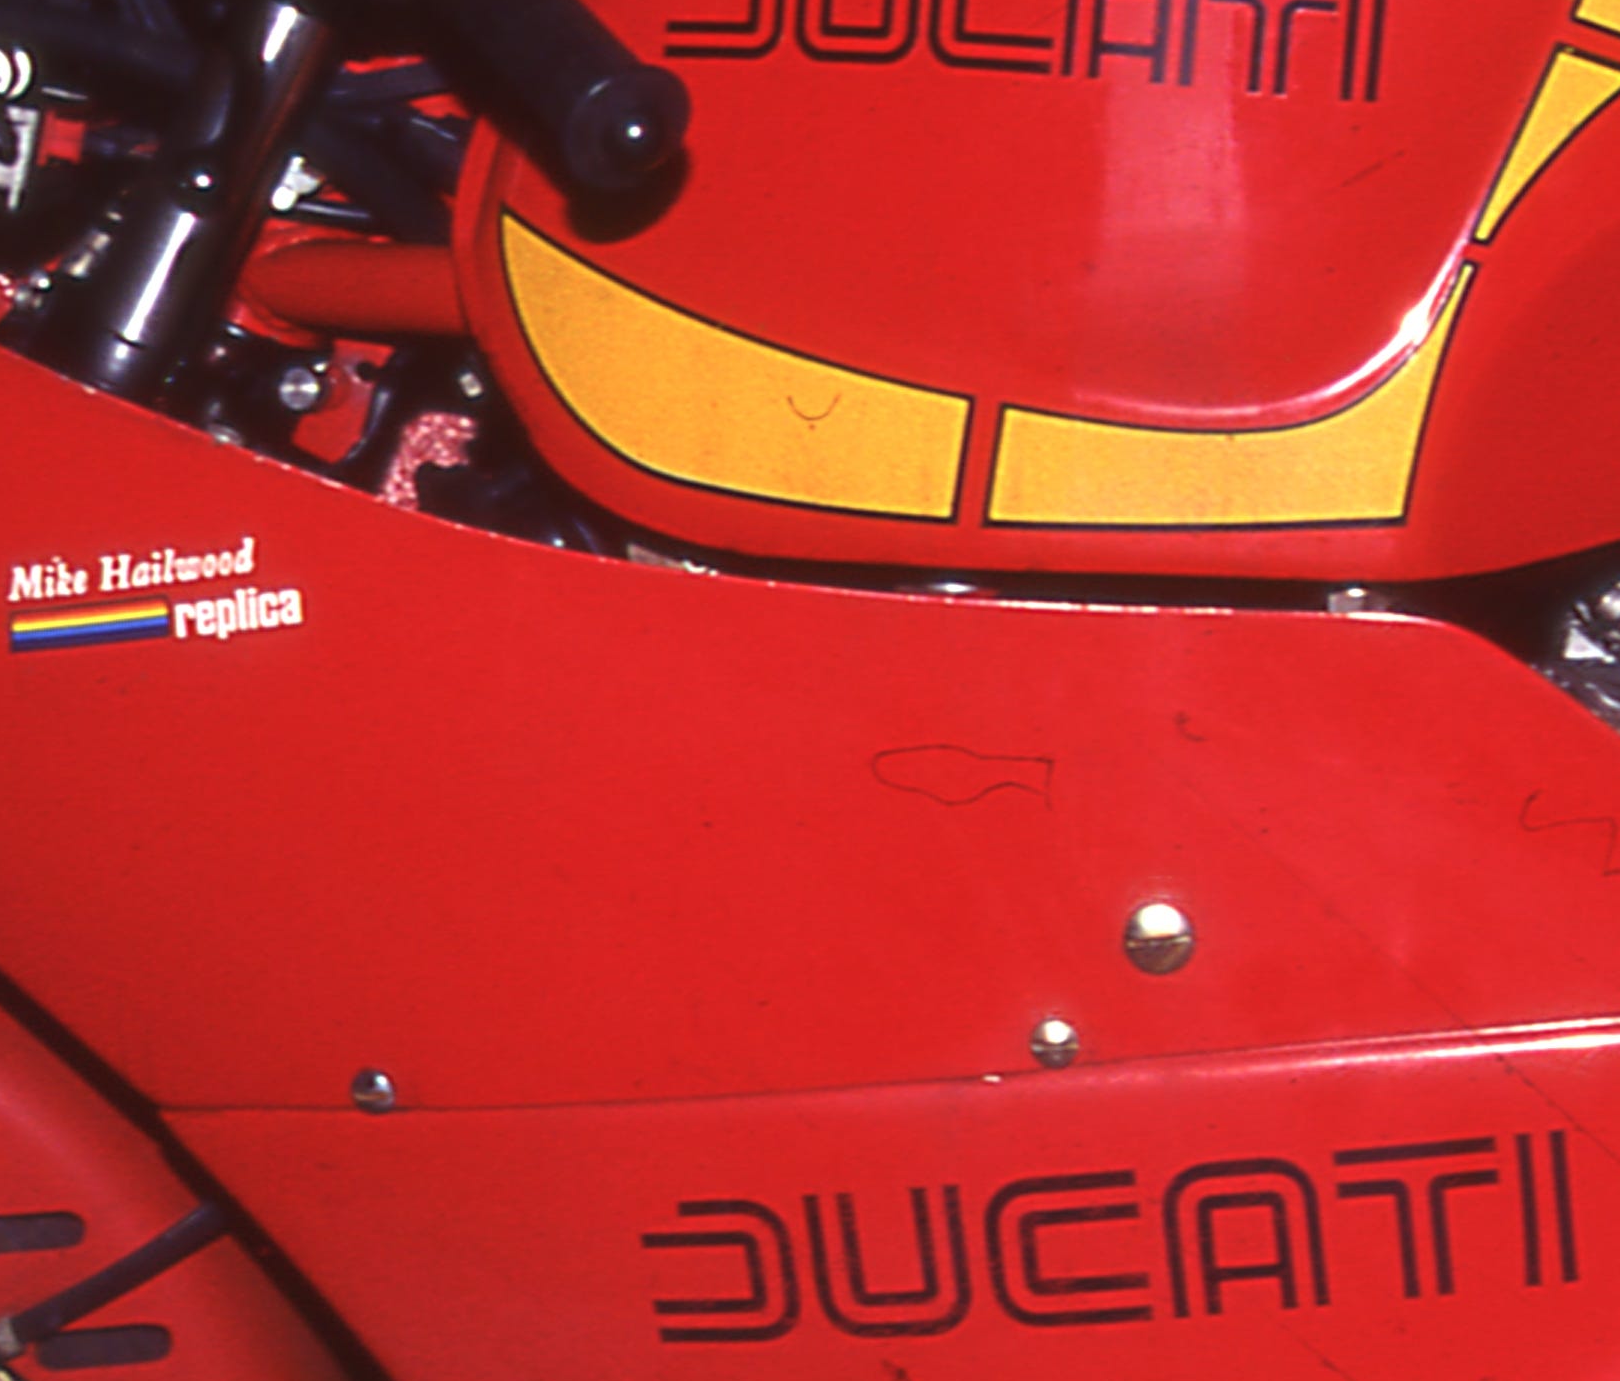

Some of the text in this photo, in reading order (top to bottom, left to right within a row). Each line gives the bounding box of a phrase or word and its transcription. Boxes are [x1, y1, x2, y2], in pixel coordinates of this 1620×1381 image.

[7, 536, 256, 602] Mike Hailwood
[173, 587, 305, 640] replica
[642, 1129, 1580, 1344] DUCATI
